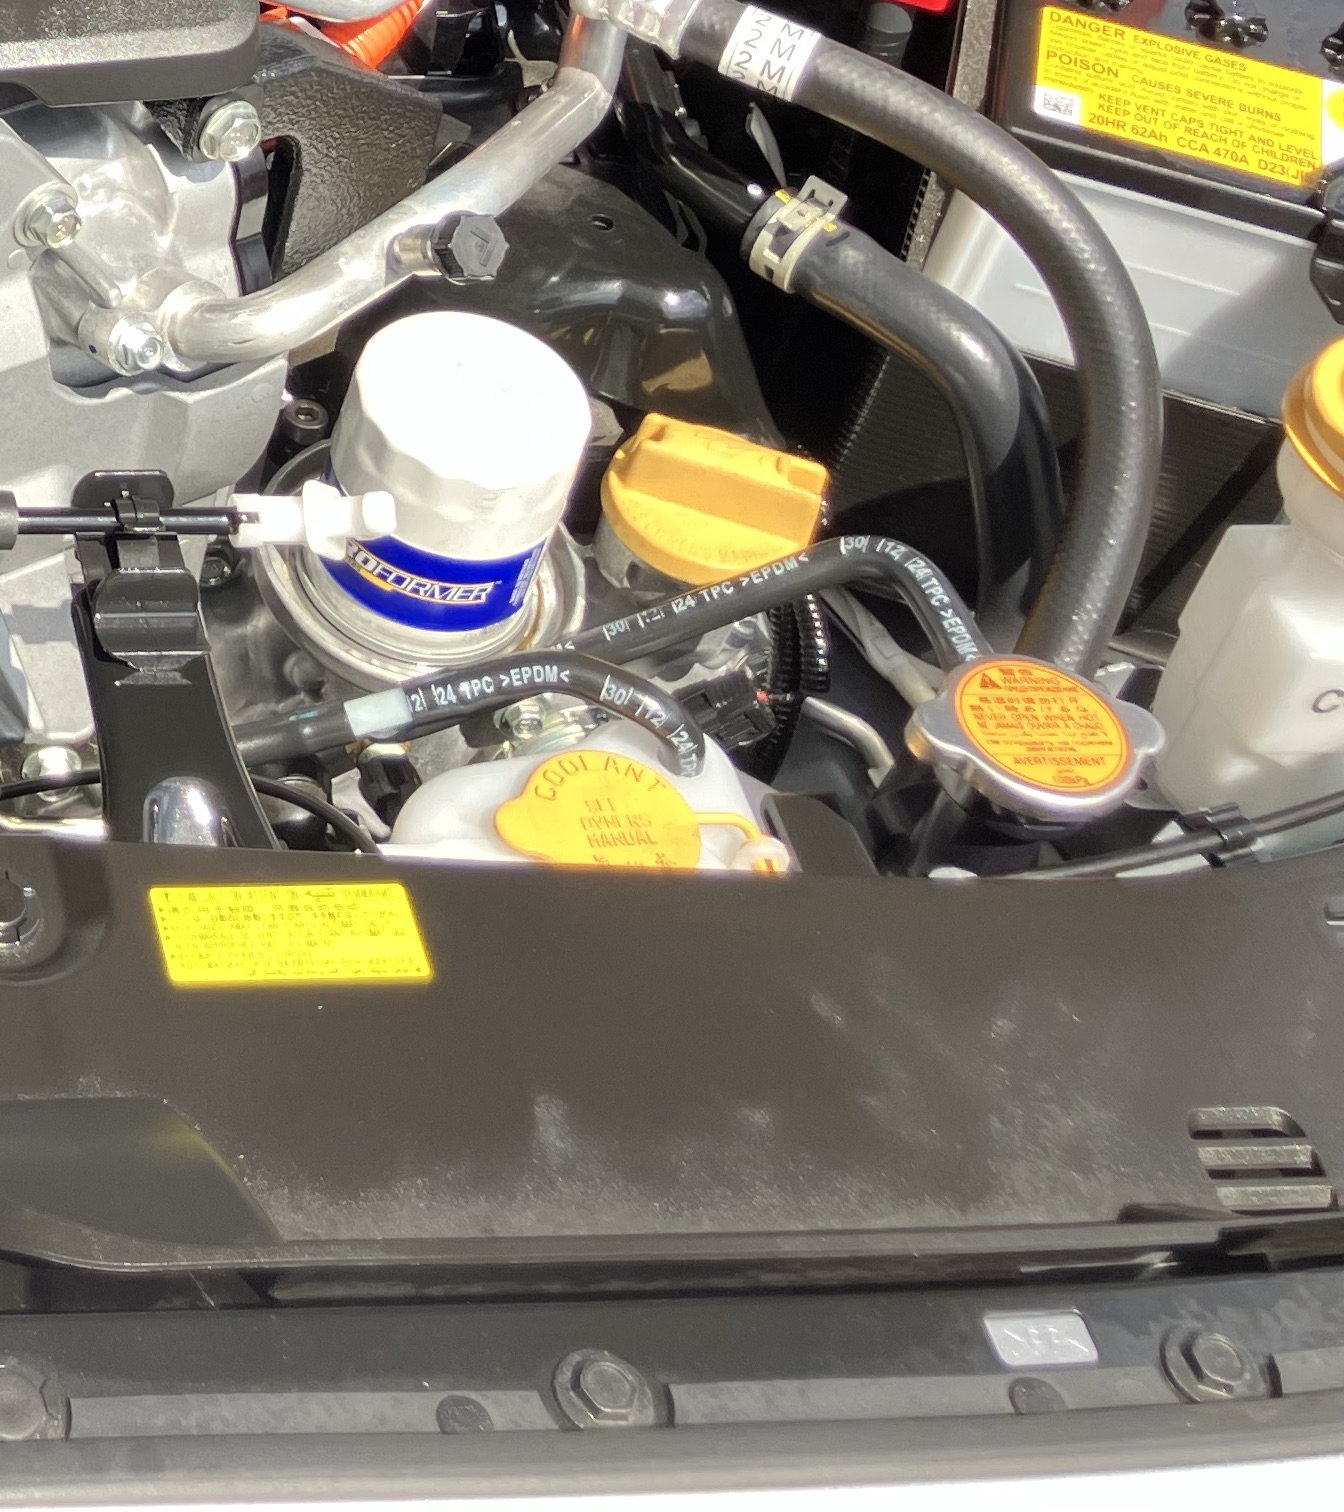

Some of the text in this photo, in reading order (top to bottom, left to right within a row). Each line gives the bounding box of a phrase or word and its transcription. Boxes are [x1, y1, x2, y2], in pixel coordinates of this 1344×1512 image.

[744, 28, 797, 61] 2 M
[1050, 11, 1247, 73] DANGER EXPLOSIVE GASES
[734, 50, 786, 84] 2 M
[1046, 49, 1281, 122] POISON CAUSES SEVERE BURNS
[1089, 112, 1126, 132] 20HR
[1131, 124, 1168, 144] 62Ah
[1177, 136, 1209, 155] CCA
[1213, 147, 1249, 166] 470A
[1098, 102, 1316, 169] KEEP OUT OF REACH OF CHILDREN
[1099, 92, 1317, 161] KEEP VENT CAPS TIGHT AND LEVEL
[700, 580, 734, 603] TPC
[459, 675, 494, 701] TPC
[500, 664, 570, 688] >EPDM<
[534, 755, 667, 802] COOLANT
[586, 831, 659, 849] MANUAL
